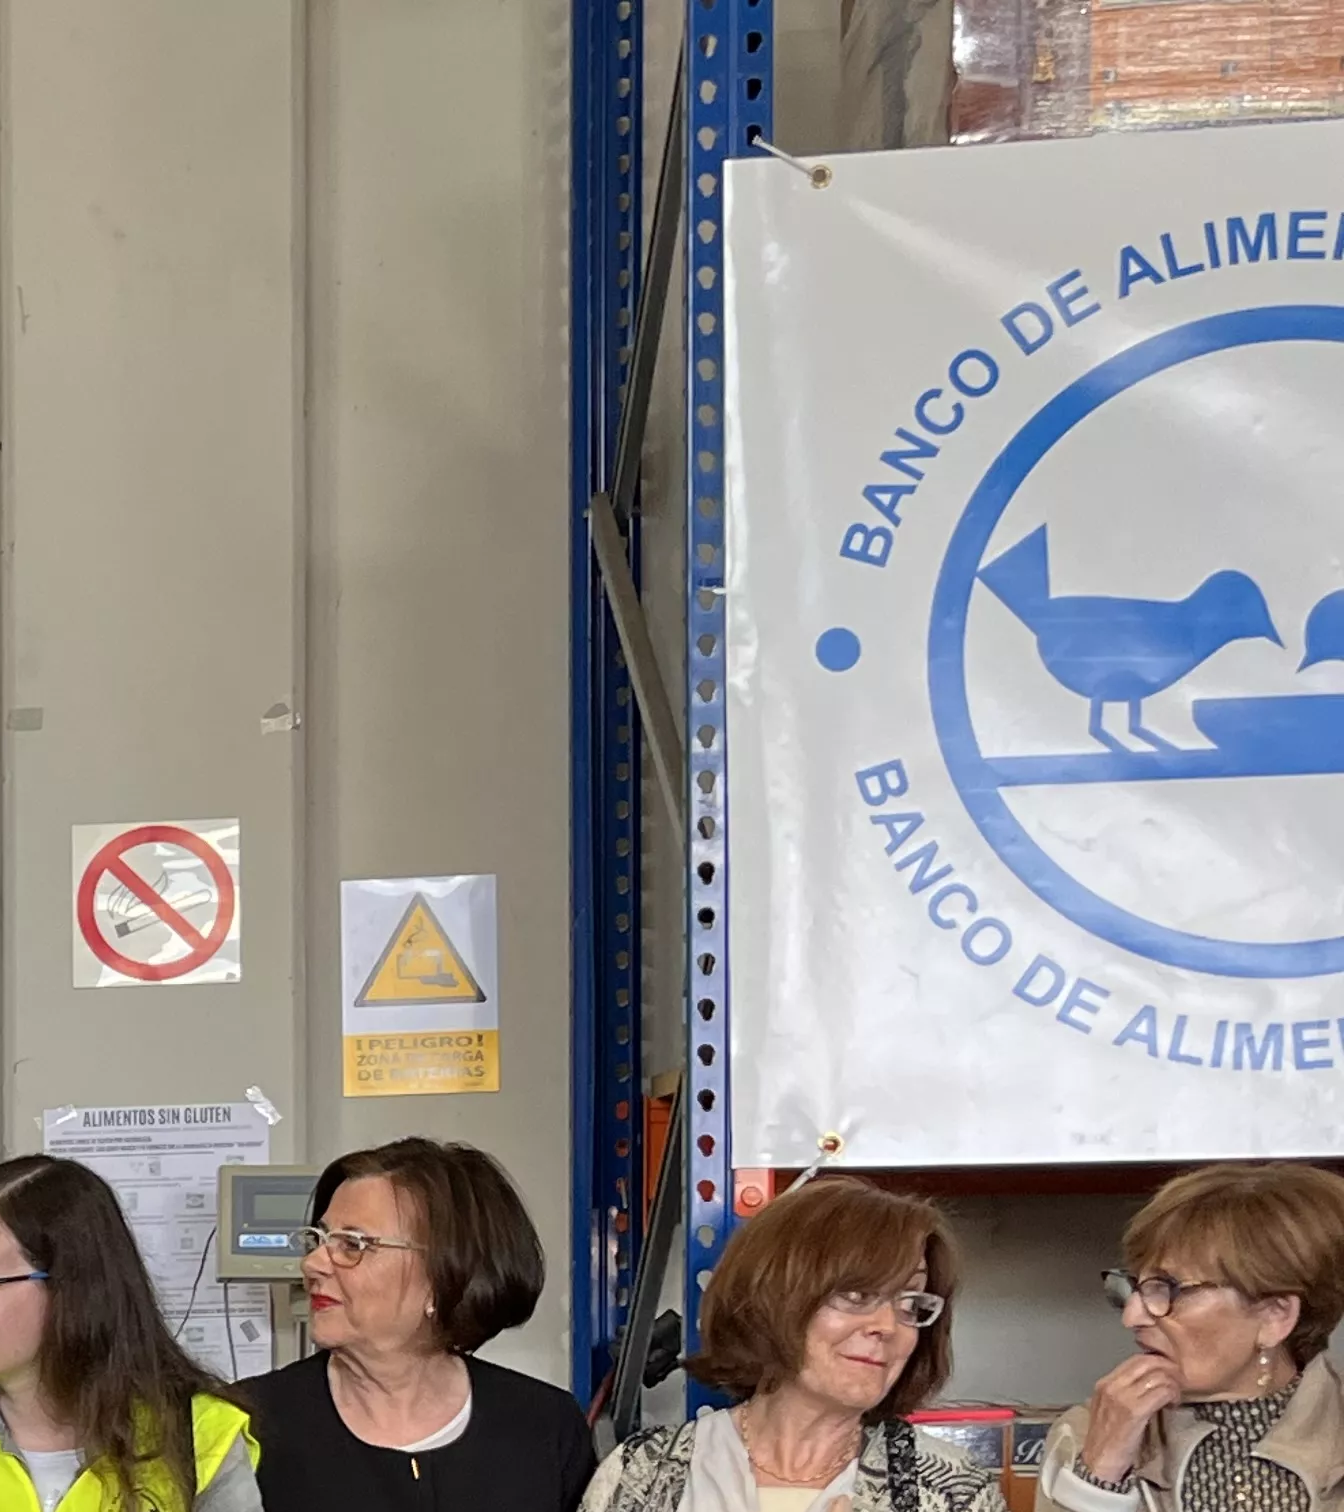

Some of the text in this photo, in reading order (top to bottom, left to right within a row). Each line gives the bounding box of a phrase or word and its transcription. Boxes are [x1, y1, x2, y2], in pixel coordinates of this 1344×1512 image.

[839, 348, 1000, 568] BANCO
[1000, 268, 1102, 356] DE
[854, 758, 1344, 1072] BANCO DE ALIME
[82, 1106, 232, 1128] ALIMENTOS SIN GLUTEN
[357, 1069, 385, 1082] DE
